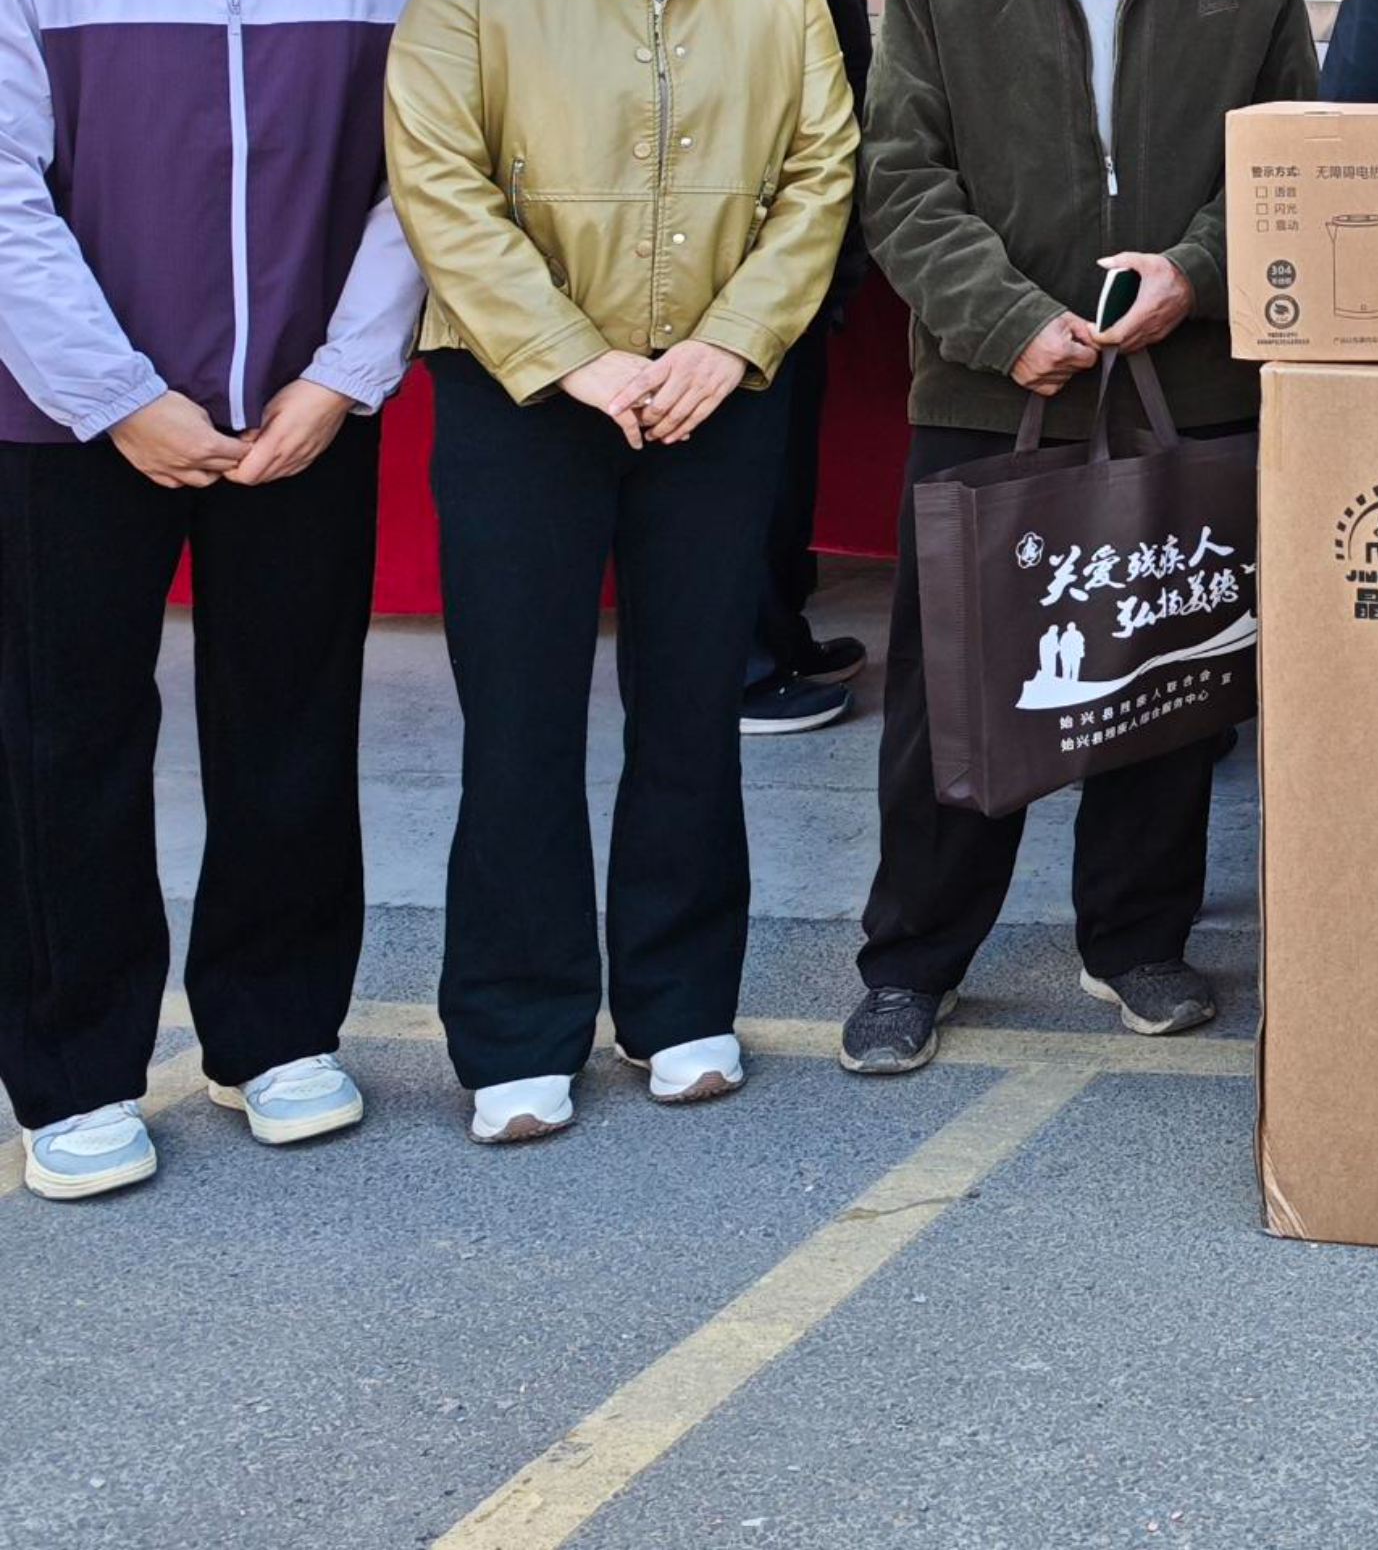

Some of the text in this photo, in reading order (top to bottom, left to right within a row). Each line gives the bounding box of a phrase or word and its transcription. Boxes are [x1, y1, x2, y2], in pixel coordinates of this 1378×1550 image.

[1274, 203, 1298, 215] 闪光
[1271, 265, 1292, 276] 304
[1040, 525, 1235, 606] 关爱残疾人
